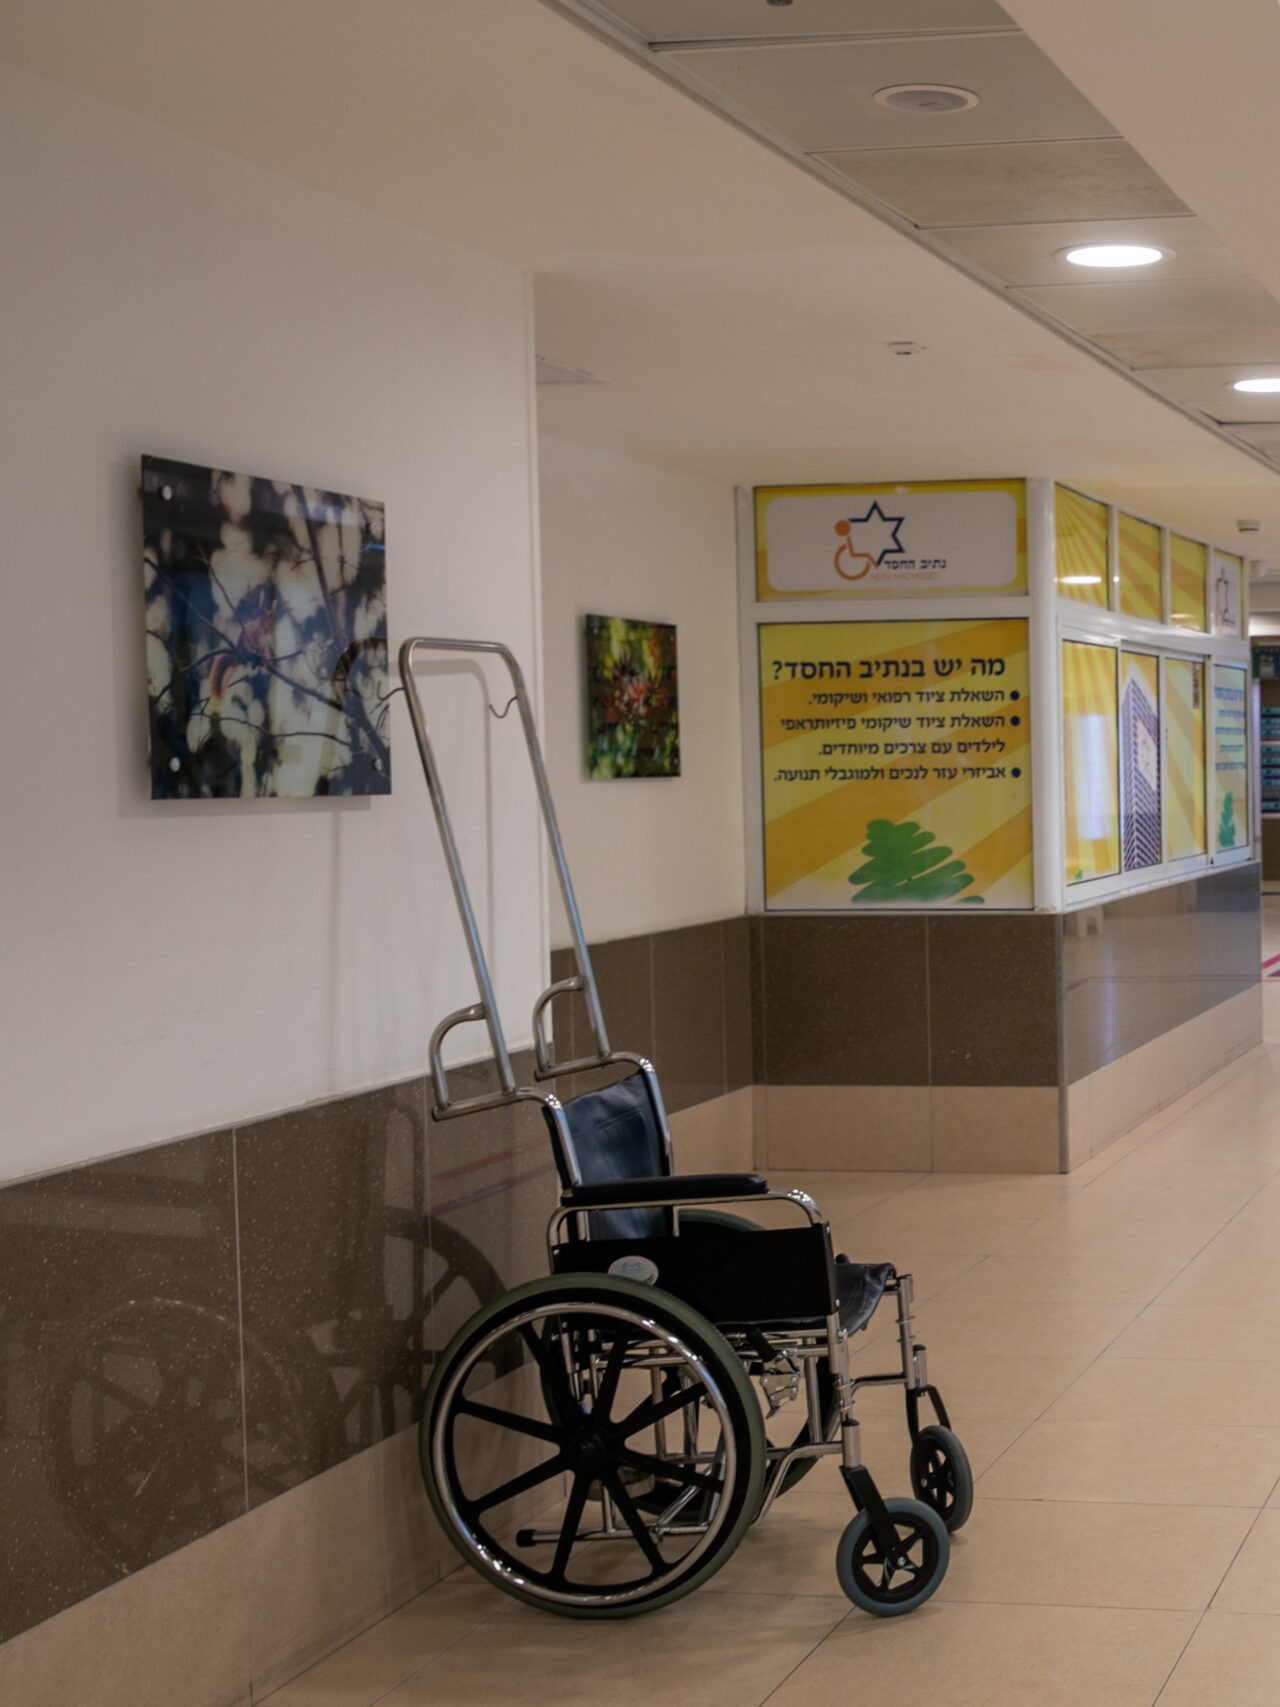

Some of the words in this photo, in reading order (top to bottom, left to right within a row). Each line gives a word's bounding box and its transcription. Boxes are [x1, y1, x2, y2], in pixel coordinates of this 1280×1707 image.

[919, 559, 947, 570] נתיב
[772, 660, 852, 681] החסד?
[859, 658, 926, 679] בנתיב
[933, 658, 962, 678] יש
[970, 657, 1006, 677] מה
[808, 692, 868, 708] ושיקומי.
[872, 691, 911, 704] רפואי
[916, 690, 945, 703] ציוד
[949, 688, 1005, 702] השאלת
[780, 717, 857, 731] פיזיותראפי
[861, 716, 912, 732] שיקומי
[916, 715, 945, 729] ציוד
[949, 713, 1005, 728] השאלת
[818, 742, 880, 756] מיוחדים.
[884, 741, 927, 755] צרכים
[931, 741, 953, 755] עם
[957, 738, 1006, 754] לילדים
[773, 768, 820, 783] תנועה.
[825, 766, 885, 782] ולמוגבלי
[889, 765, 929, 781] לנכים
[933, 767, 958, 781] עזר
[962, 766, 1006, 780] אביזרי
